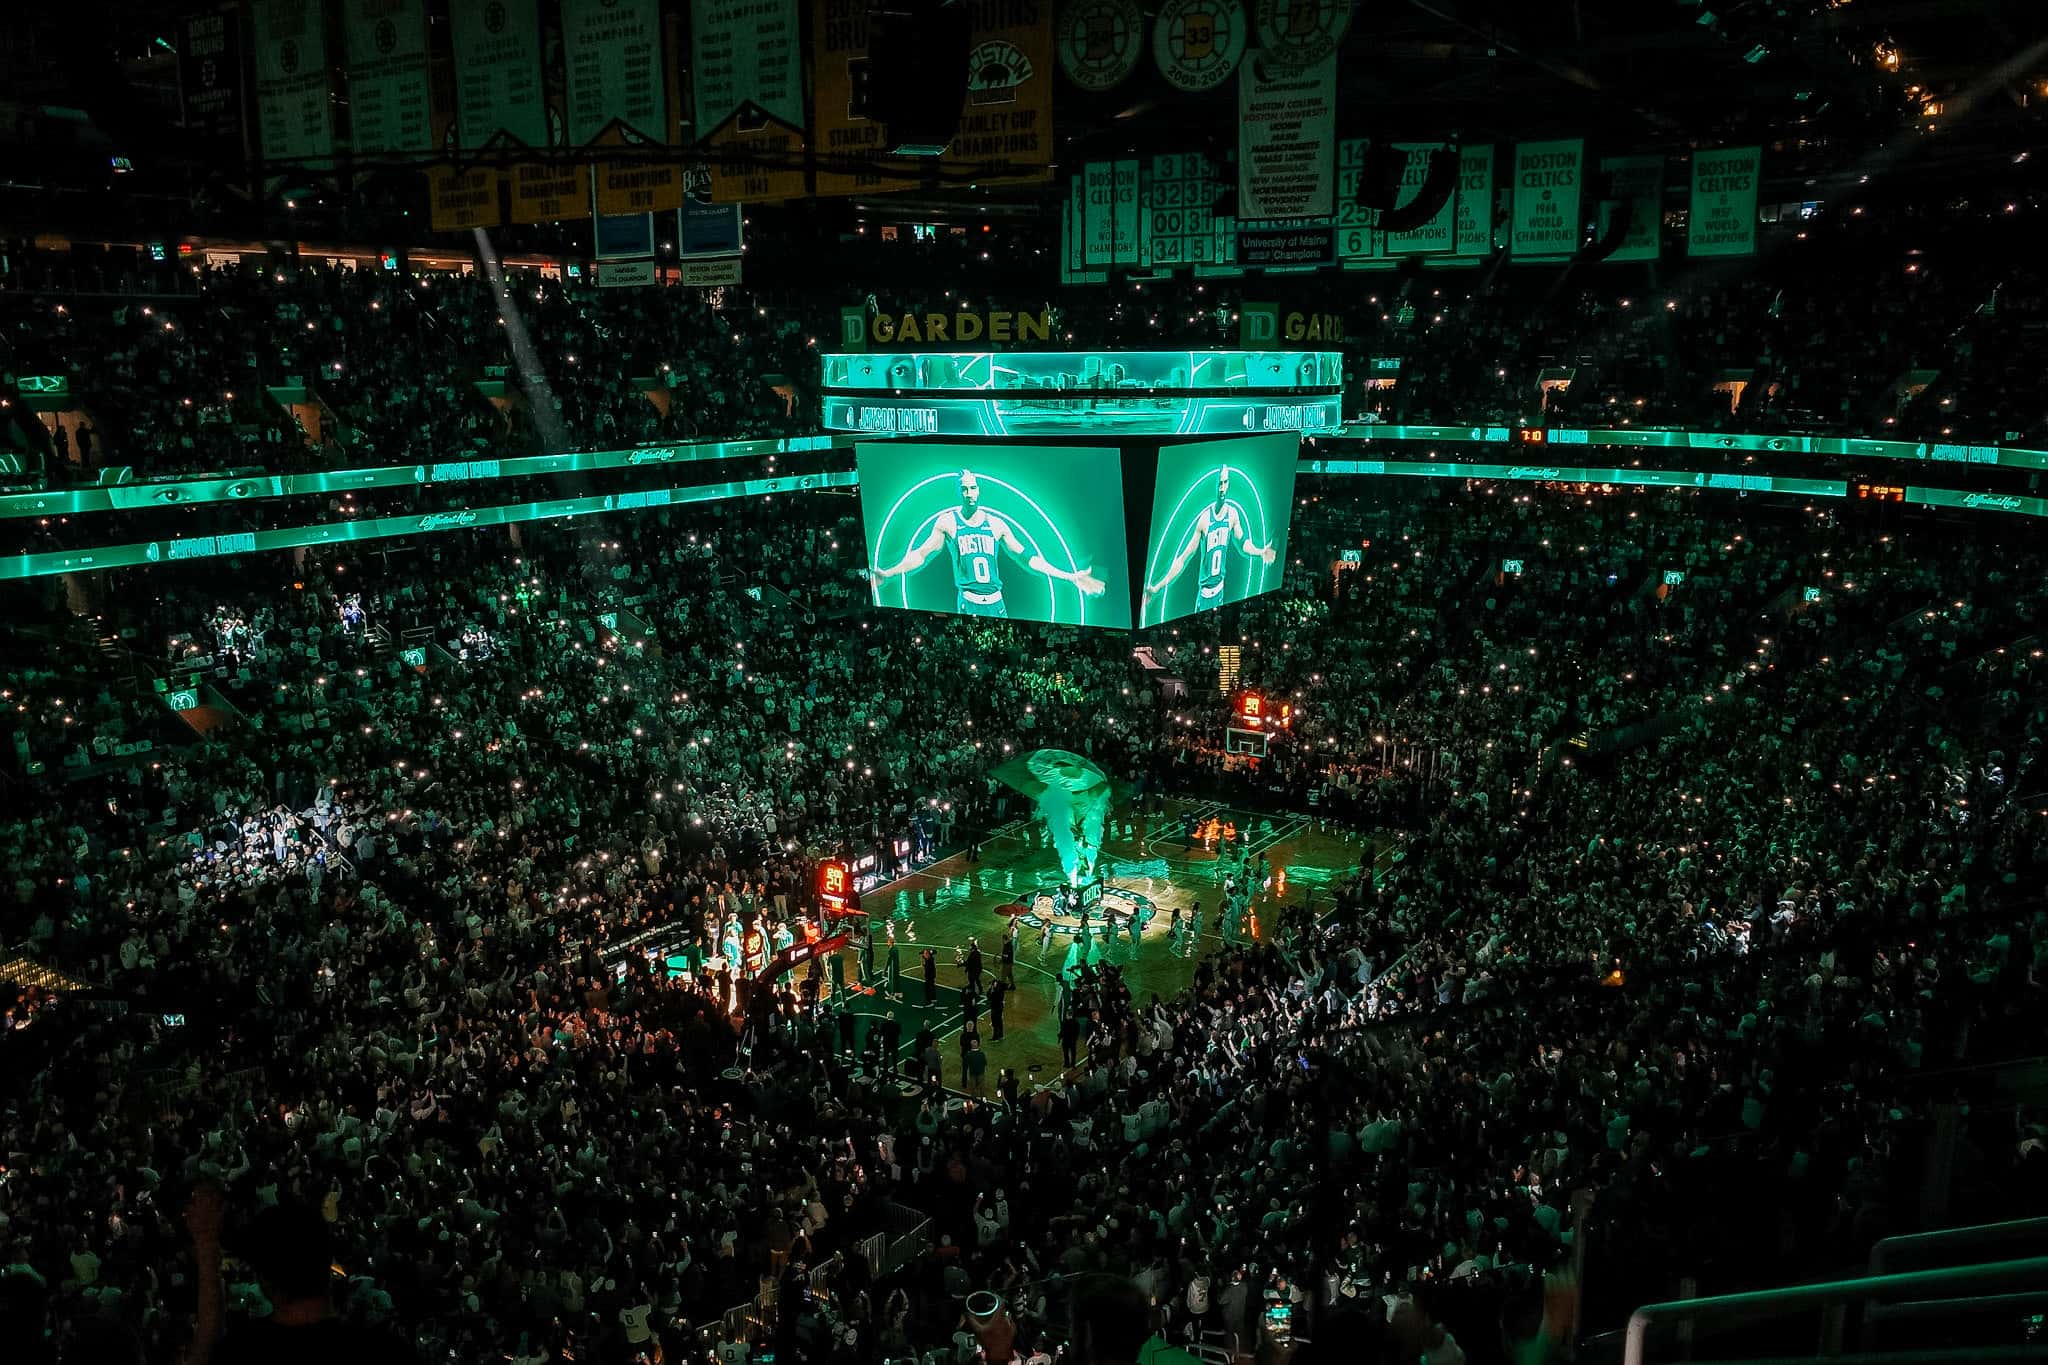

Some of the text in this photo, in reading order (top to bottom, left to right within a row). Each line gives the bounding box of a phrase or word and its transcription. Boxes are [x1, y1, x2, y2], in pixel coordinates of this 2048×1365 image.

[708, 1, 779, 24] CHAMPIONS
[1187, 27, 1211, 46] 33
[1244, 107, 1328, 123] BOSTON UNIVERSITY
[1249, 102, 1285, 113] BOSTON
[960, 110, 1037, 132] TANLEY CUP
[953, 132, 1038, 156] CHAMPIONS
[1162, 157, 1174, 177] 3
[1520, 152, 1578, 171] BOSTON
[1698, 157, 1755, 177] BOSTON
[1090, 171, 1135, 188] BOSON
[1520, 170, 1576, 188] CELTICS
[1698, 175, 1751, 193] CELTICS
[1091, 186, 1133, 205] CELICS
[1155, 183, 1181, 206] 32
[1155, 210, 1182, 233] 00
[1190, 209, 1212, 232] 31
[1341, 200, 1369, 225] 25
[1528, 216, 1566, 230] WORLD
[1703, 219, 1741, 233] WORLD
[1242, 234, 1328, 249] University of Maine
[1347, 229, 1361, 252] 6
[1393, 228, 1448, 242] CHAMPIONS
[1516, 230, 1575, 243] CHAMPIONS
[1691, 231, 1751, 245] CHAMPIONS
[1090, 239, 1133, 254] CHAMIONS
[1155, 238, 1181, 260] 34
[1193, 240, 1205, 259] 5
[1272, 248, 1321, 262] Champions
[618, 274, 648, 284] CHAMPIONS
[702, 273, 735, 283] CHAMPIONS
[872, 311, 1051, 344] GARDEN
[1244, 311, 1276, 341] TD
[859, 406, 896, 431] JAYSON
[896, 408, 938, 433] TATUM
[1246, 407, 1255, 430] 0
[1263, 406, 1303, 430] JAYSON
[432, 462, 470, 482] JAYSON
[168, 536, 216, 560] JAYSON
[973, 556, 991, 584] 0
[1211, 549, 1222, 577] 0
[825, 877, 844, 893] 24
[725, 1349, 736, 1361] 0
